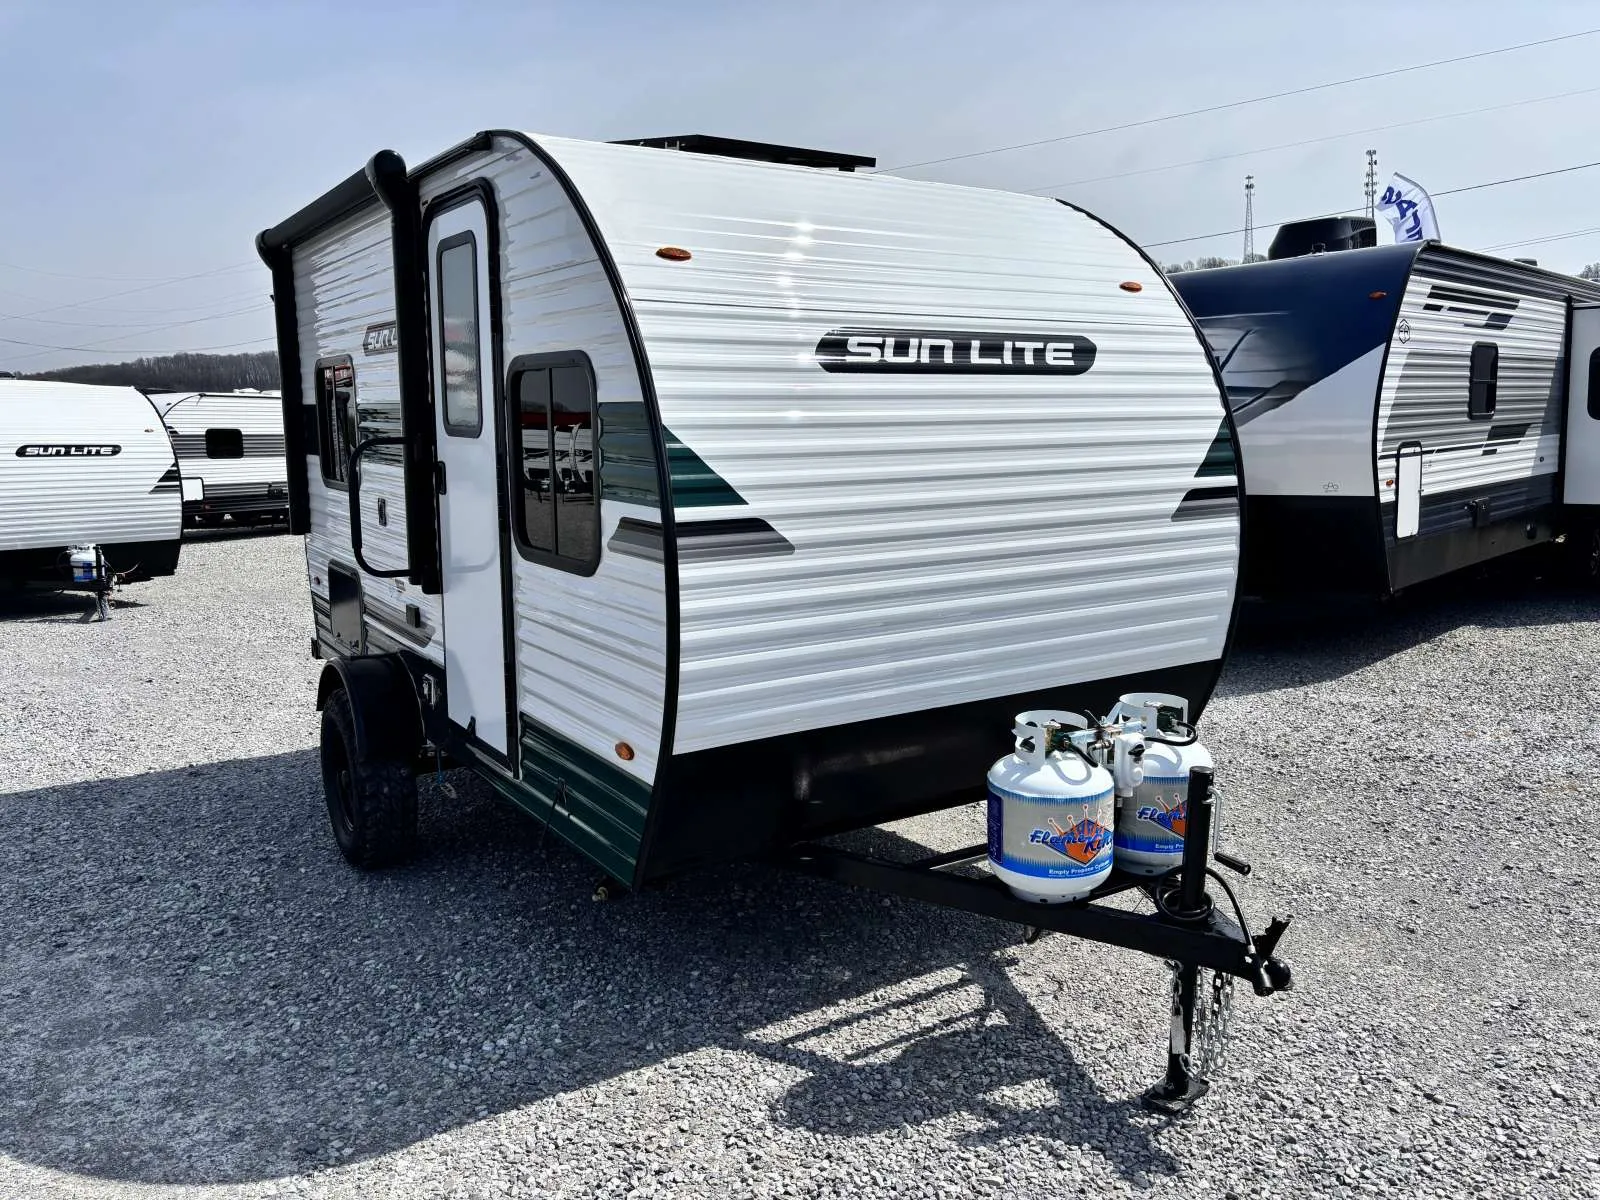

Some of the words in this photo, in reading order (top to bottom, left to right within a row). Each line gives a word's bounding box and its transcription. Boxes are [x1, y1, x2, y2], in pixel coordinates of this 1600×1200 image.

[846, 335, 954, 364] SUN
[970, 339, 1076, 366] LITE
[25, 446, 66, 456] SUN
[70, 446, 113, 455] LITE
